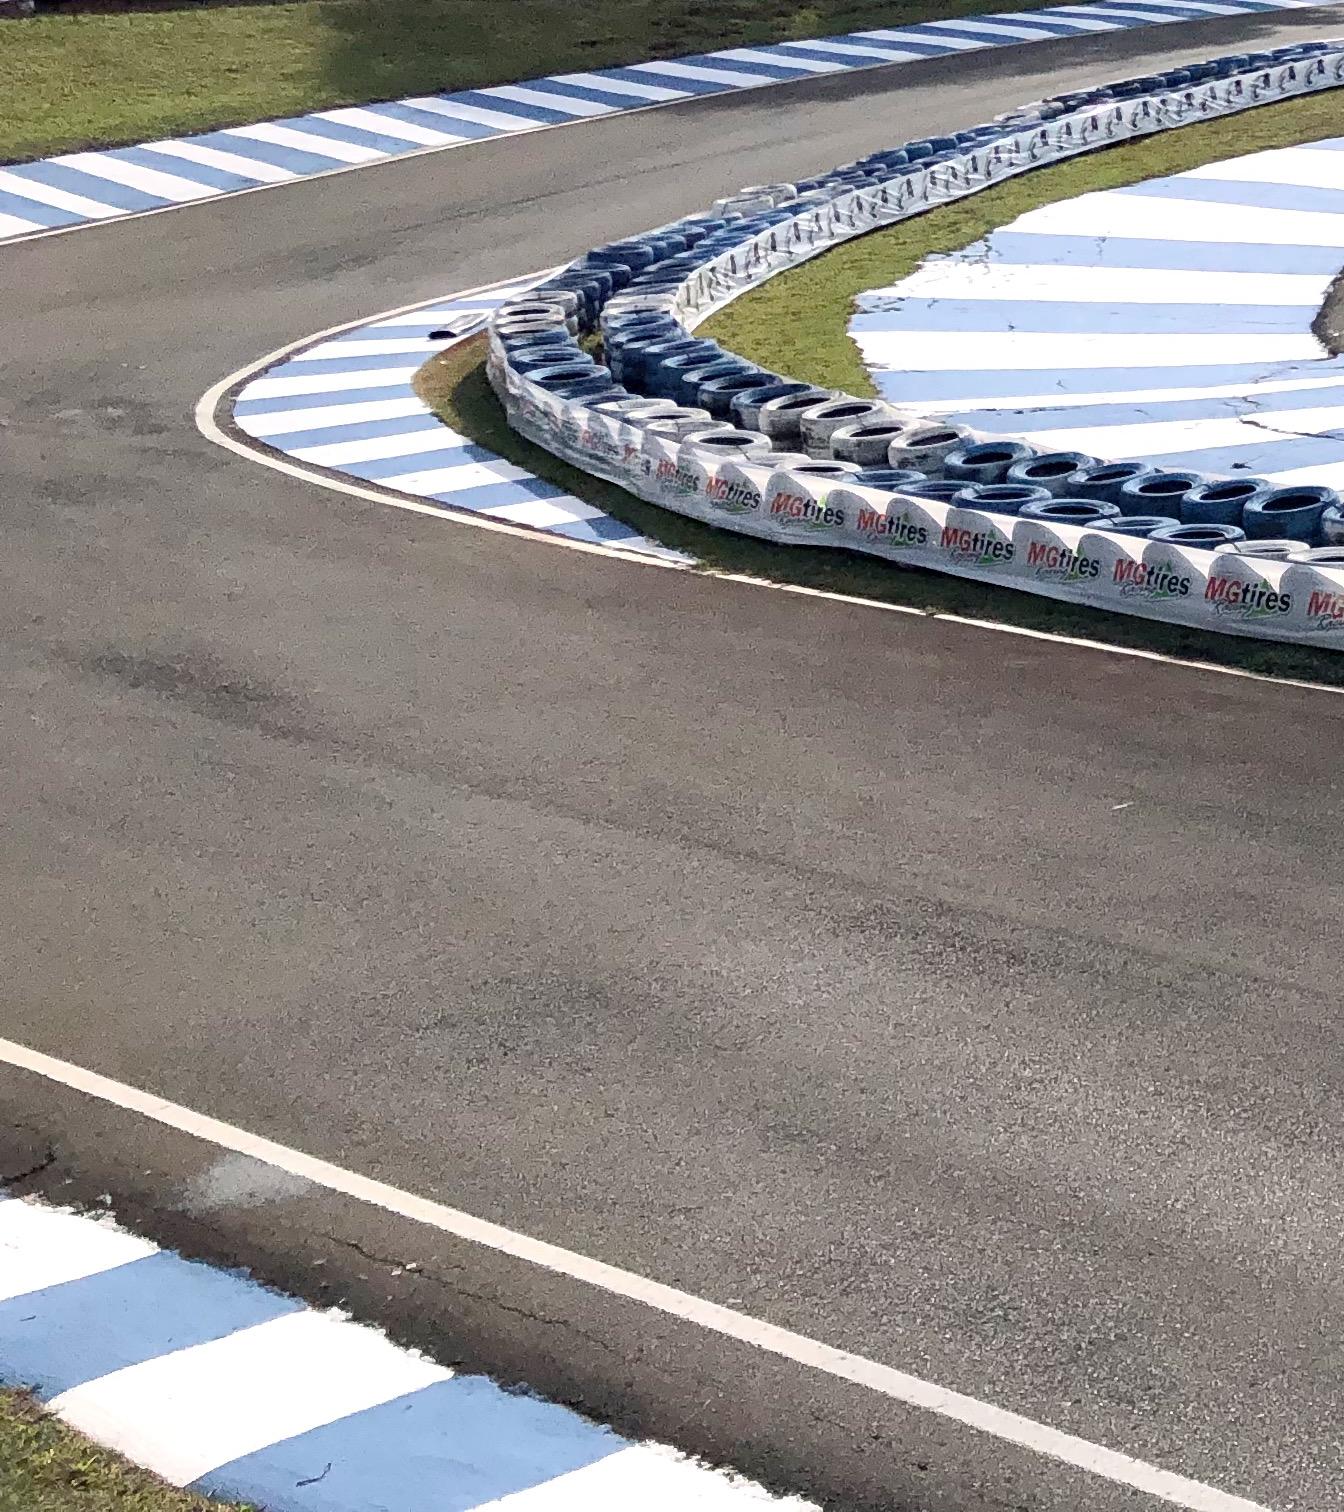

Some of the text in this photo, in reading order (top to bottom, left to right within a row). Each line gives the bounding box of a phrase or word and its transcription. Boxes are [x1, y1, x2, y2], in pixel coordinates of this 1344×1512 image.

[706, 475, 761, 510] MGtires
[771, 492, 845, 527] MGtires
[857, 508, 927, 544] MGtires
[941, 526, 1015, 561] MGtires
[1028, 541, 1100, 578] MGtires
[1113, 558, 1191, 596] MGtires
[1205, 576, 1291, 614] MGtires
